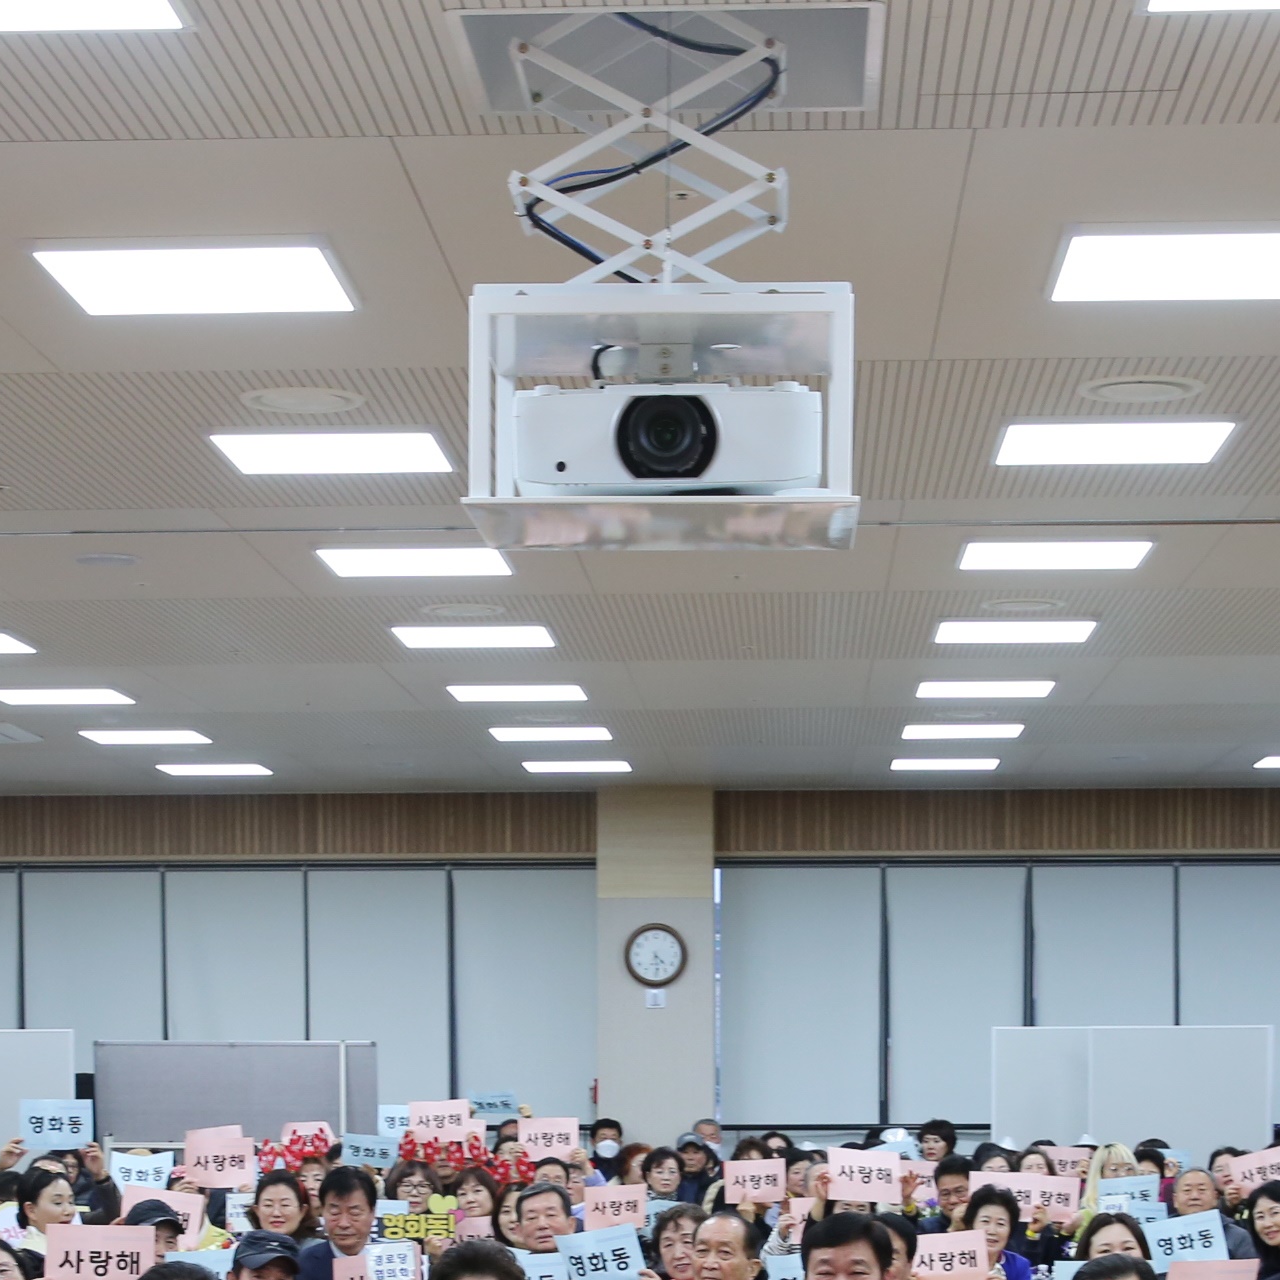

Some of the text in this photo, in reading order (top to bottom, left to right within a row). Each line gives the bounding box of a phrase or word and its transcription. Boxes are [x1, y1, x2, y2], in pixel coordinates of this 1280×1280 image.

[29, 1116, 83, 1133] 영화동
[416, 1114, 461, 1129] 사랑해
[526, 1133, 570, 1147] 사랑해
[349, 1145, 389, 1159] 영화동
[193, 1155, 244, 1172] 사랑해
[120, 1167, 164, 1181] 영화동
[732, 1174, 778, 1189] 사랑해
[838, 1166, 892, 1184] 사랑해
[1041, 1191, 1070, 1207] 랑해
[592, 1200, 638, 1216] 사랑해
[382, 1214, 455, 1240] 영화동!
[1157, 1230, 1213, 1256] 영화동
[59, 1251, 141, 1276] 사랑해
[569, 1248, 630, 1276] 영화동
[917, 1250, 977, 1271] 사랑해
